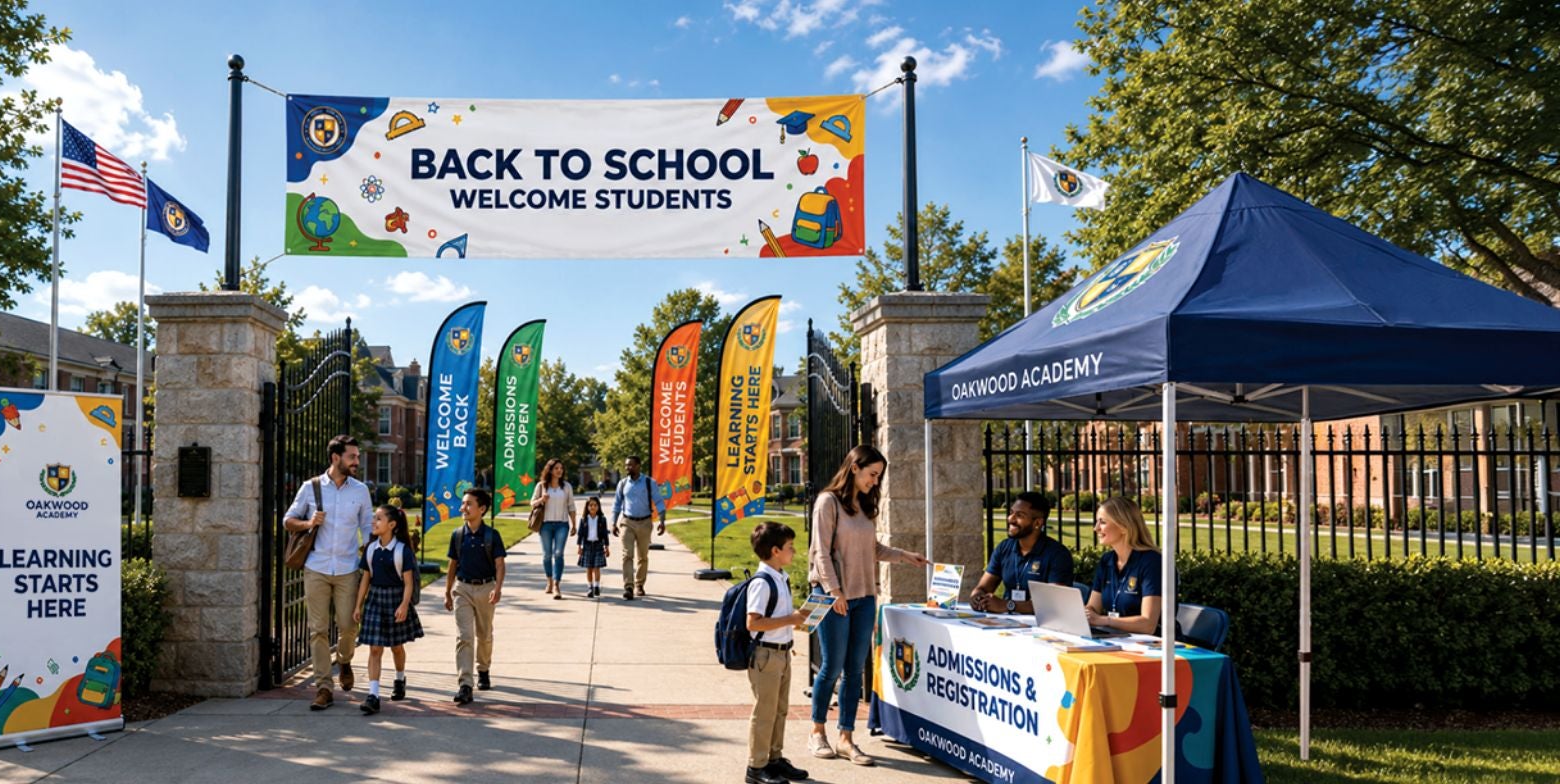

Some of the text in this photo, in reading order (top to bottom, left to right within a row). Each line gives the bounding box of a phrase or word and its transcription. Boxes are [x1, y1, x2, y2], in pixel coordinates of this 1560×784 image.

[411, 148, 775, 181] BACK TO SCHOOL
[449, 188, 733, 210] WELCOME STUDENTS
[951, 351, 1104, 401] OAKWOOD ACADEMY
[435, 373, 453, 470] WELCOME
[453, 394, 469, 448] BACK
[503, 375, 518, 471] ADMISSIONS
[517, 403, 530, 446] OPEN
[658, 381, 674, 465] WELCOME
[672, 381, 688, 465] STUDENTS
[726, 375, 745, 468] LEARNING
[743, 365, 761, 476] STARTS HERE
[26, 500, 89, 510] OAKWOOD
[36, 511, 79, 519] ACADEMY
[14, 573, 99, 594] STARTS
[27, 598, 87, 619] HERE
[927, 644, 1037, 703] ADMISSIONS &
[927, 671, 1039, 737] REGISTRATION
[918, 727, 1015, 784] OAKWOOD ACADEMY
